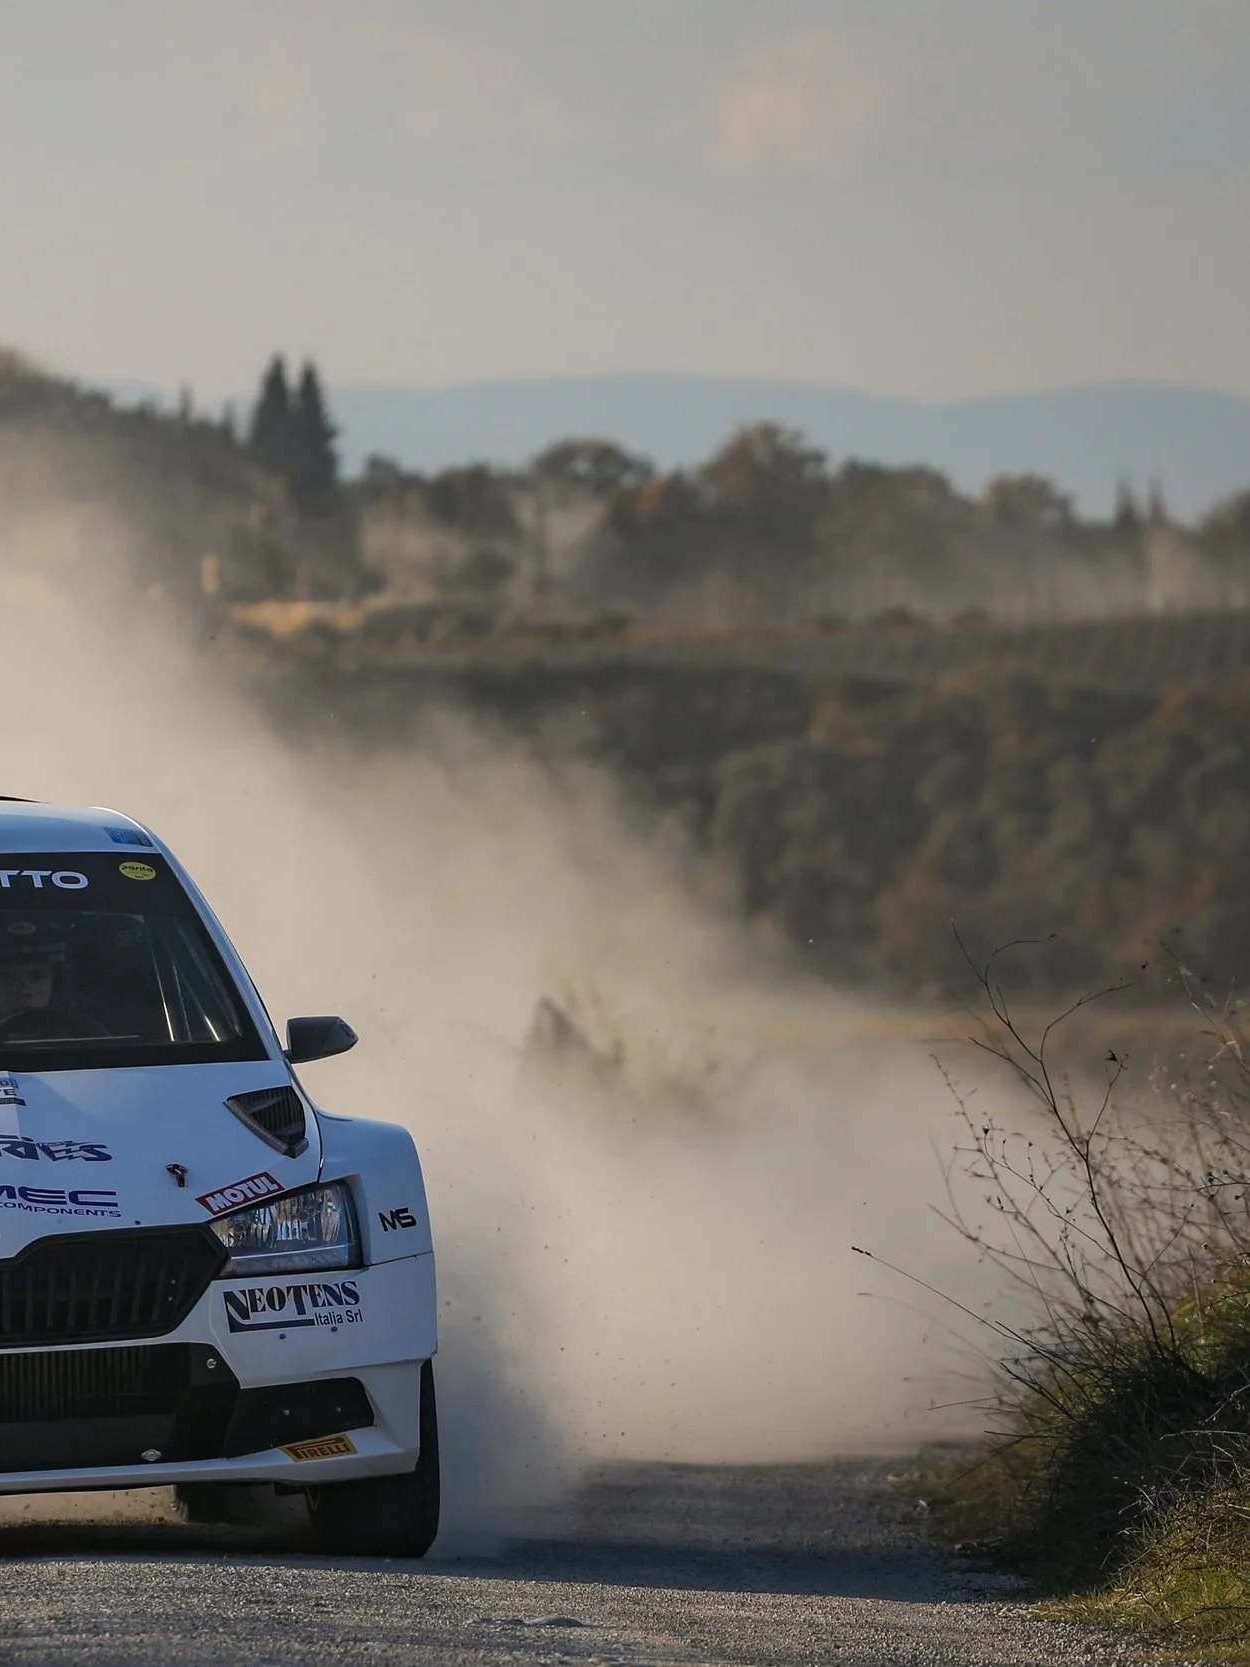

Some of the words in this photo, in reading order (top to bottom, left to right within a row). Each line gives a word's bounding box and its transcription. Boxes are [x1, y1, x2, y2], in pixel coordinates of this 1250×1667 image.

[206, 1175, 279, 1212] MOTUL
[378, 1207, 417, 1232] MS
[223, 1281, 360, 1327] NEOTENS
[315, 1315, 343, 1326] Italia
[346, 1309, 363, 1323] Srl
[286, 1437, 350, 1459] PIRELLI
